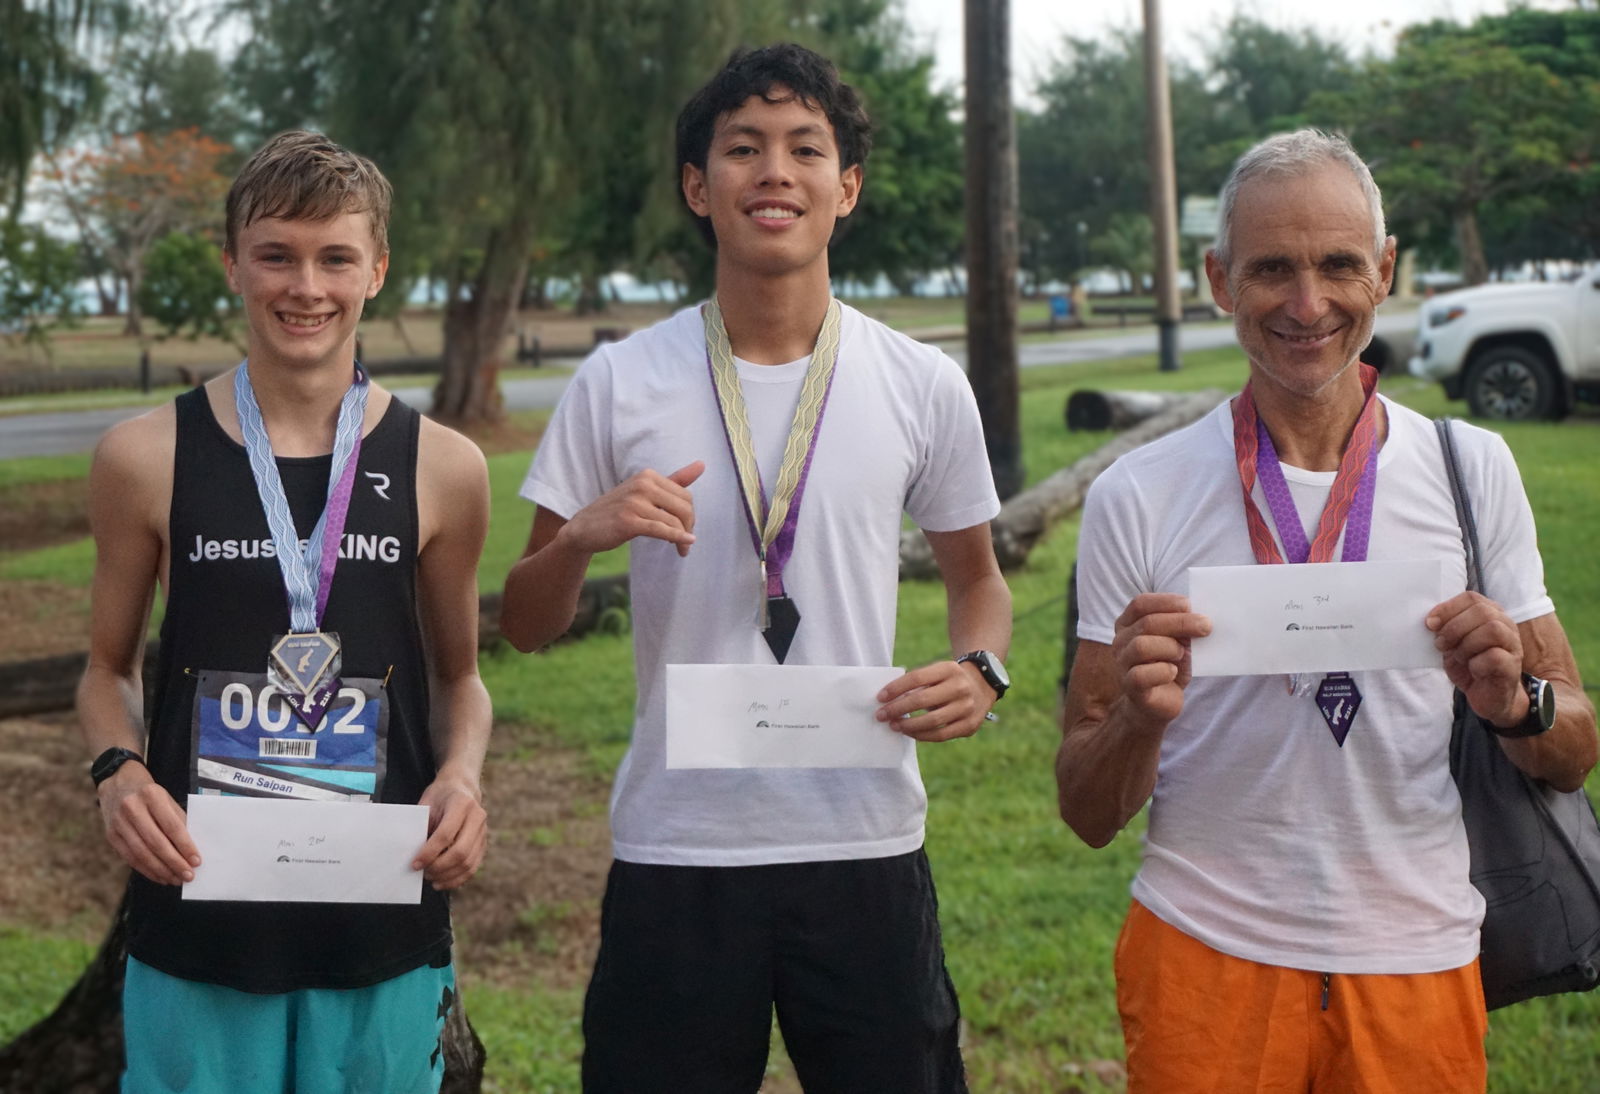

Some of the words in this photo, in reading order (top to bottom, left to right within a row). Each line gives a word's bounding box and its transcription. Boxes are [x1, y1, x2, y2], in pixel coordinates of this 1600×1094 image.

[189, 534, 277, 562] Jesus
[233, 771, 254, 784] Run
[256, 777, 294, 793] Saipan
